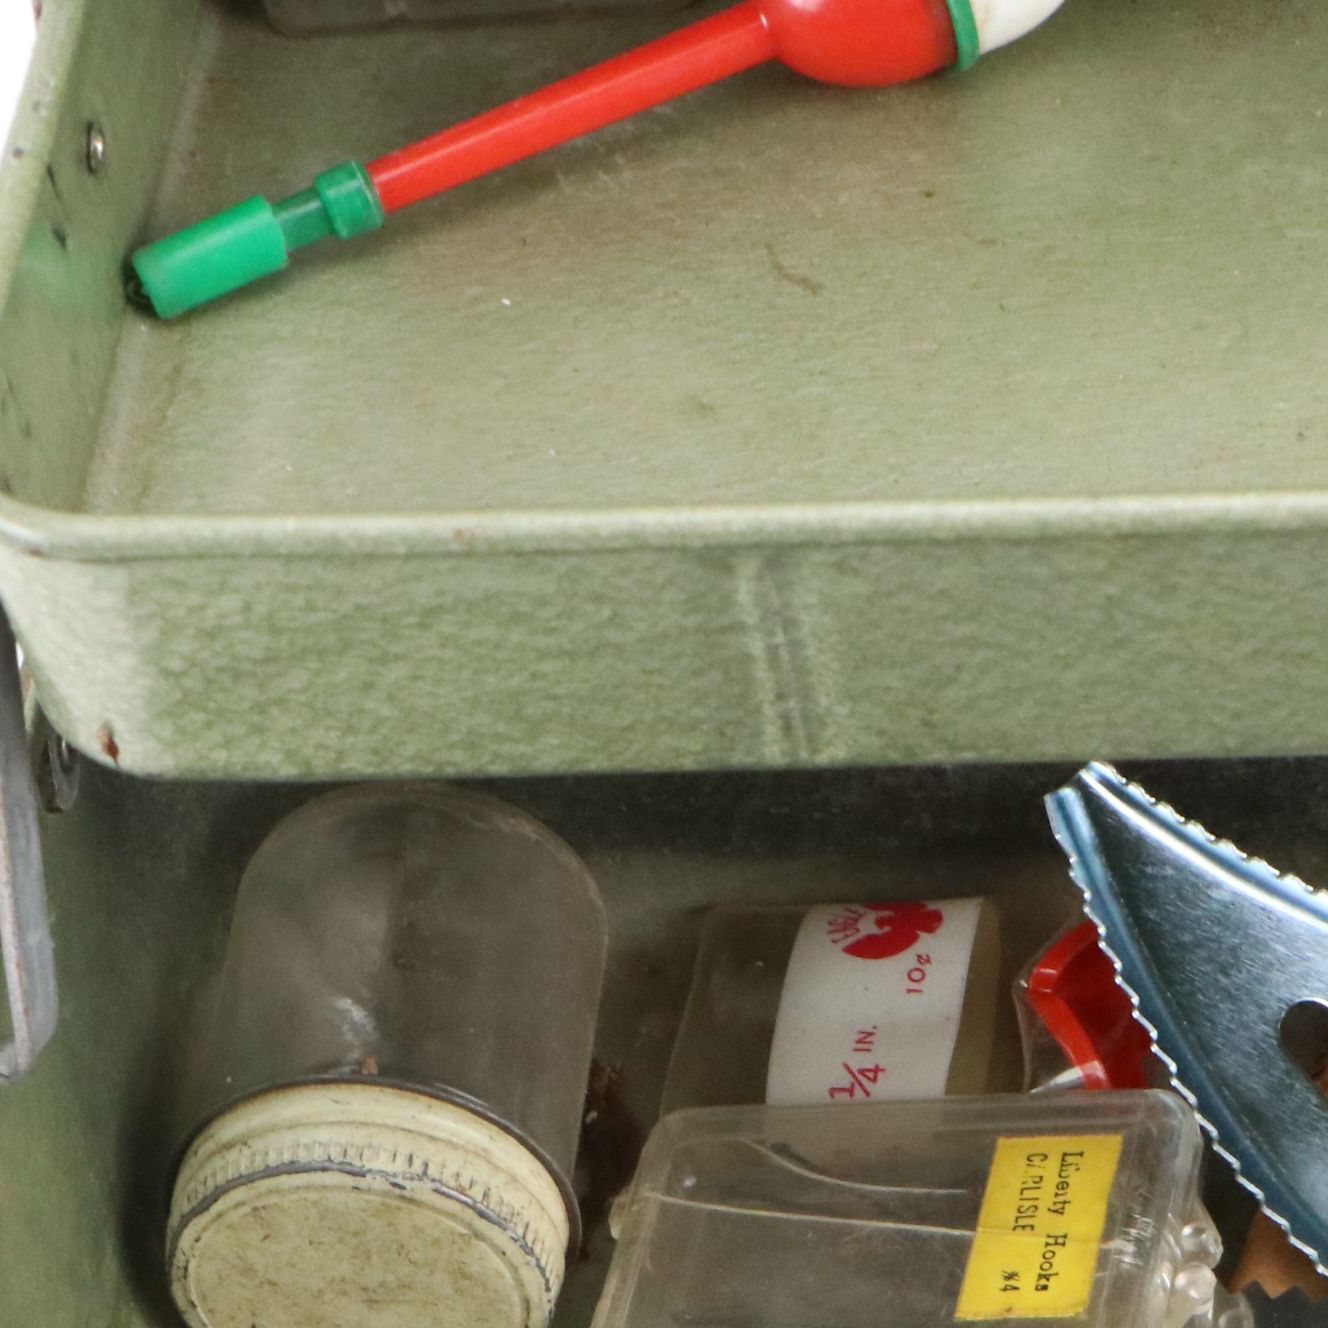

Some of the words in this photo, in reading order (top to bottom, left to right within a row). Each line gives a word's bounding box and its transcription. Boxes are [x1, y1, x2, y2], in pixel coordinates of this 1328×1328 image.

[906, 953, 933, 995] 10¢
[853, 1024, 878, 1053] IN.
[828, 1062, 887, 1099] 1/4
[1034, 1232, 1068, 1292] Hooks
